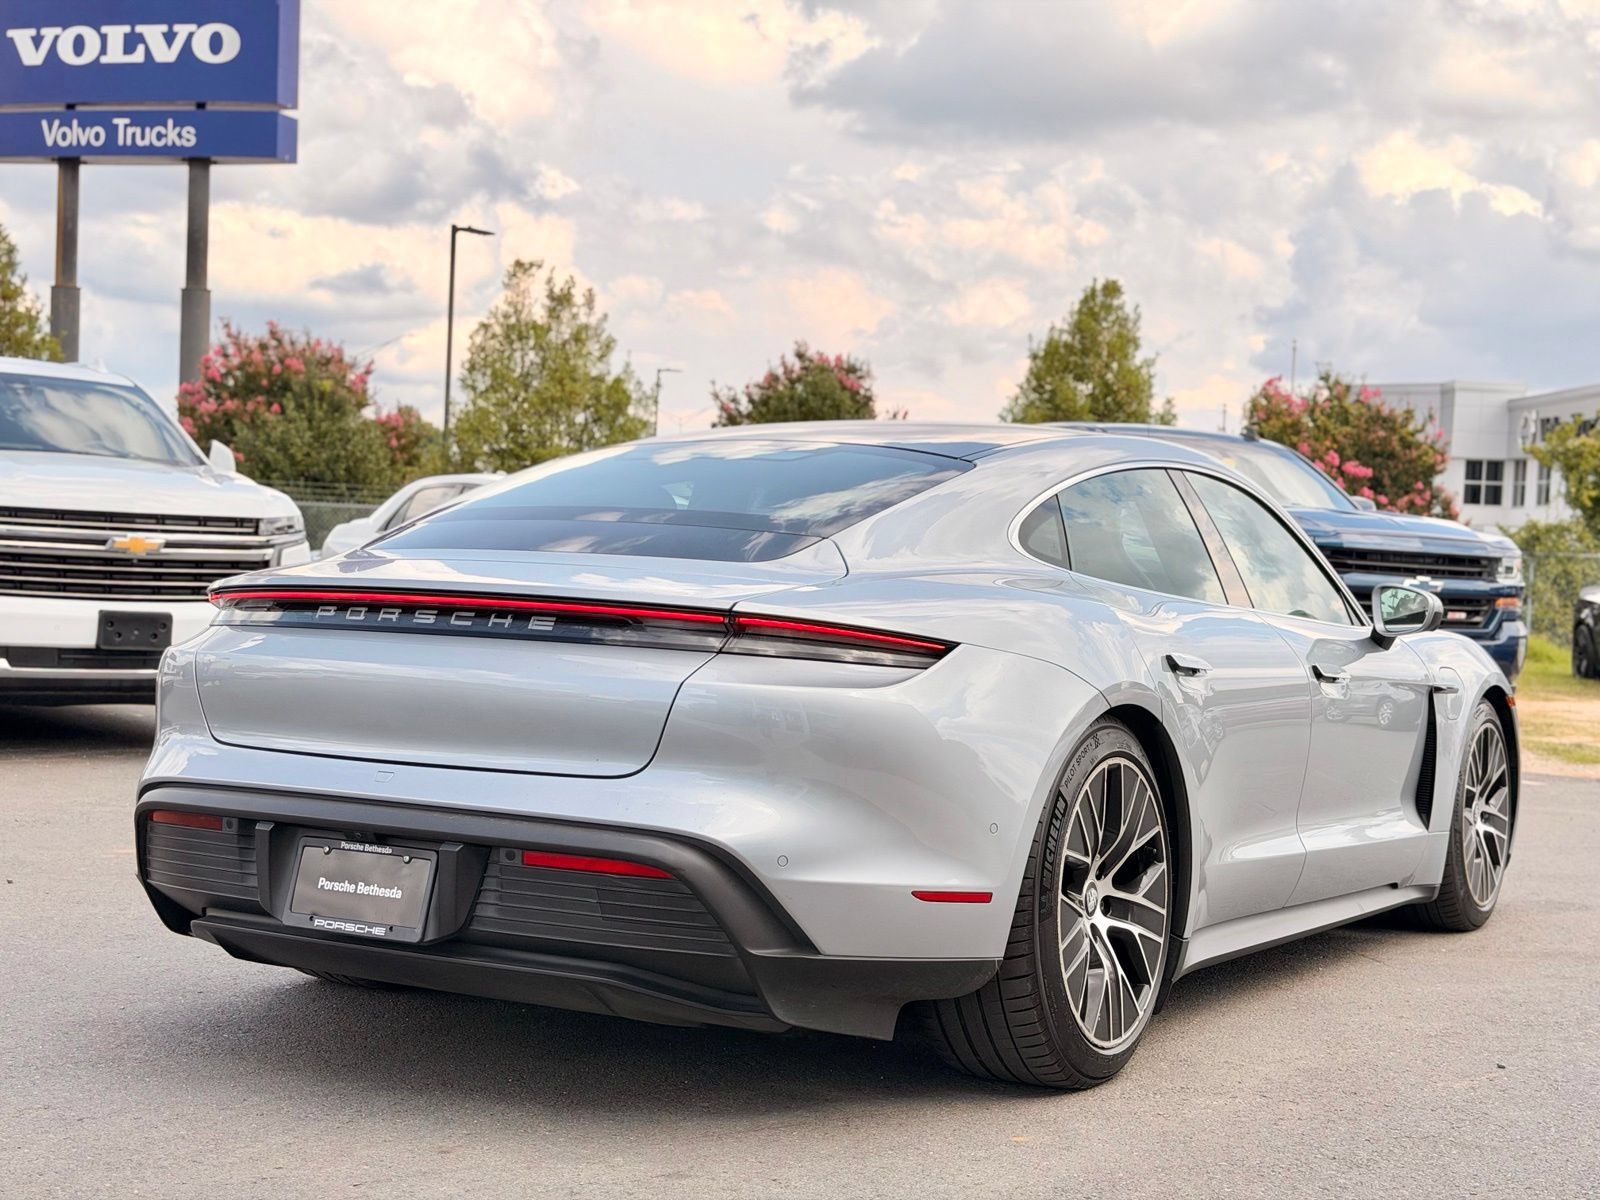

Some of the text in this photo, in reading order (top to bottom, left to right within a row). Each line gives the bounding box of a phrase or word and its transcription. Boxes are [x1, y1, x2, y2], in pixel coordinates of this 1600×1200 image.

[6, 23, 241, 66] VOLVO
[41, 118, 197, 147] Volvo Trucks
[315, 606, 556, 630] PORSCHE
[1064, 764, 1077, 789] PILOT
[1076, 744, 1090, 766] SPORT
[341, 841, 392, 854] Porsche Bethesda
[1043, 797, 1066, 890] MICHELIN
[318, 877, 402, 899] Porsche Bethesda
[314, 918, 386, 935] PORSCHE
